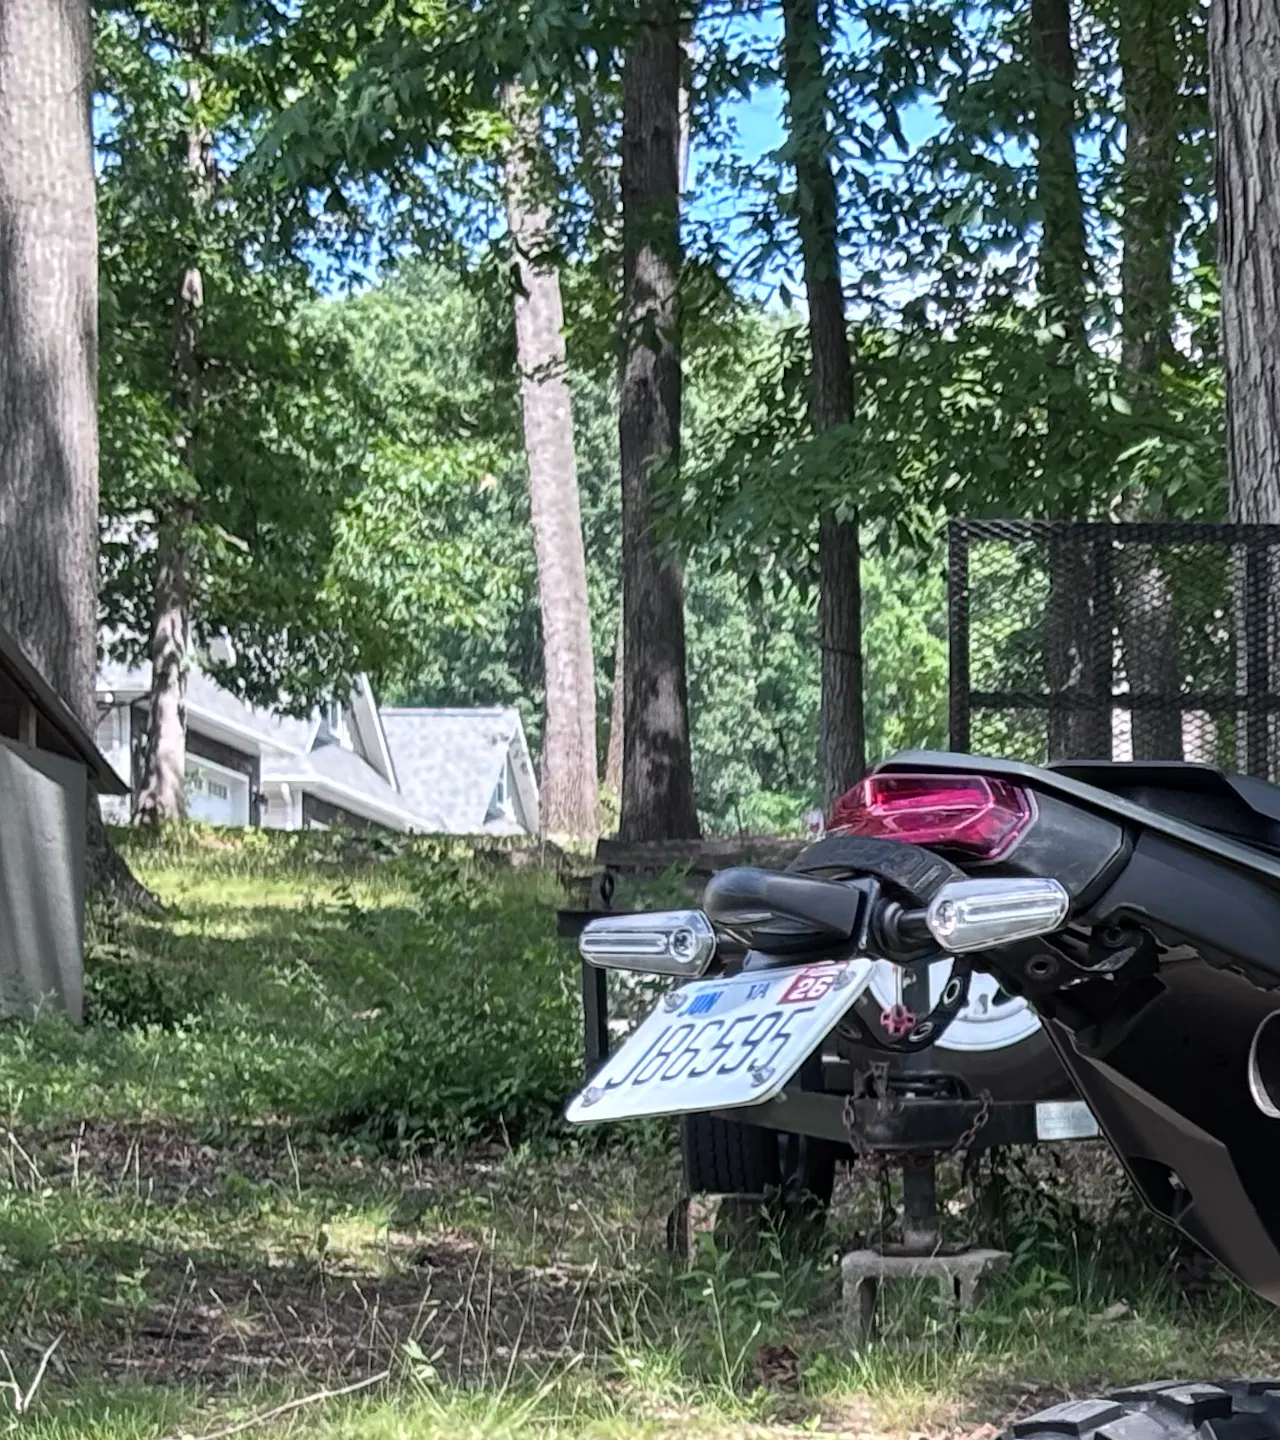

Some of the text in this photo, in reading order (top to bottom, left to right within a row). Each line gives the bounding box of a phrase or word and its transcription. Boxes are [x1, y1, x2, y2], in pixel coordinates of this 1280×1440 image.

[677, 976, 834, 1018] JUN VA 26
[604, 1006, 816, 1090] J86595
